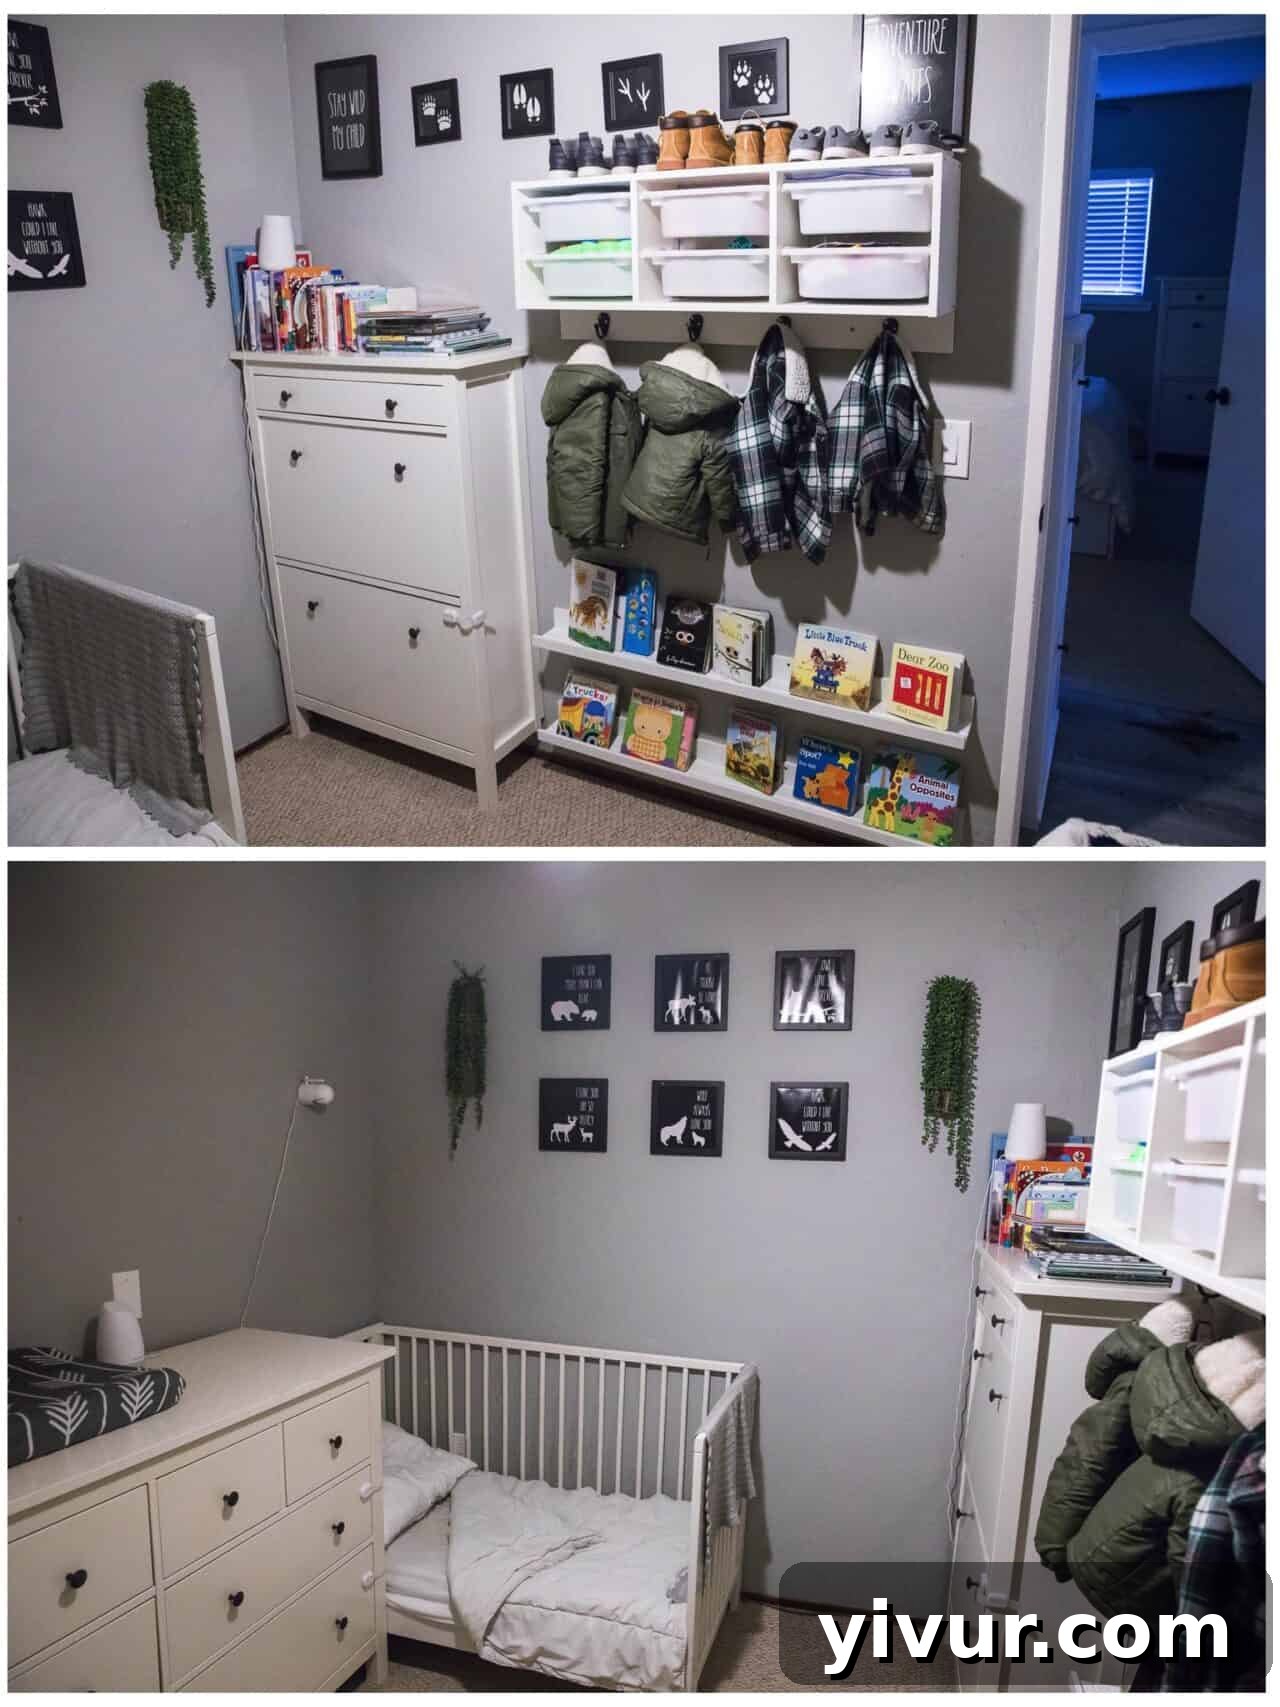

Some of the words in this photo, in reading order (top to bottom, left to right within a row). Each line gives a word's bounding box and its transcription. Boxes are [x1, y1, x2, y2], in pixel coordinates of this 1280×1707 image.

[327, 91, 347, 119] STAY
[348, 88, 366, 116] WILD
[331, 124, 345, 151] MY
[346, 122, 366, 150] CHILD
[804, 628, 826, 641] Little
[826, 631, 844, 645] Blue
[844, 635, 869, 653] Truck
[897, 646, 926, 663] Dear
[927, 655, 950, 673] Zoo
[910, 782, 955, 802] Opposites
[918, 775, 949, 790] Animal
